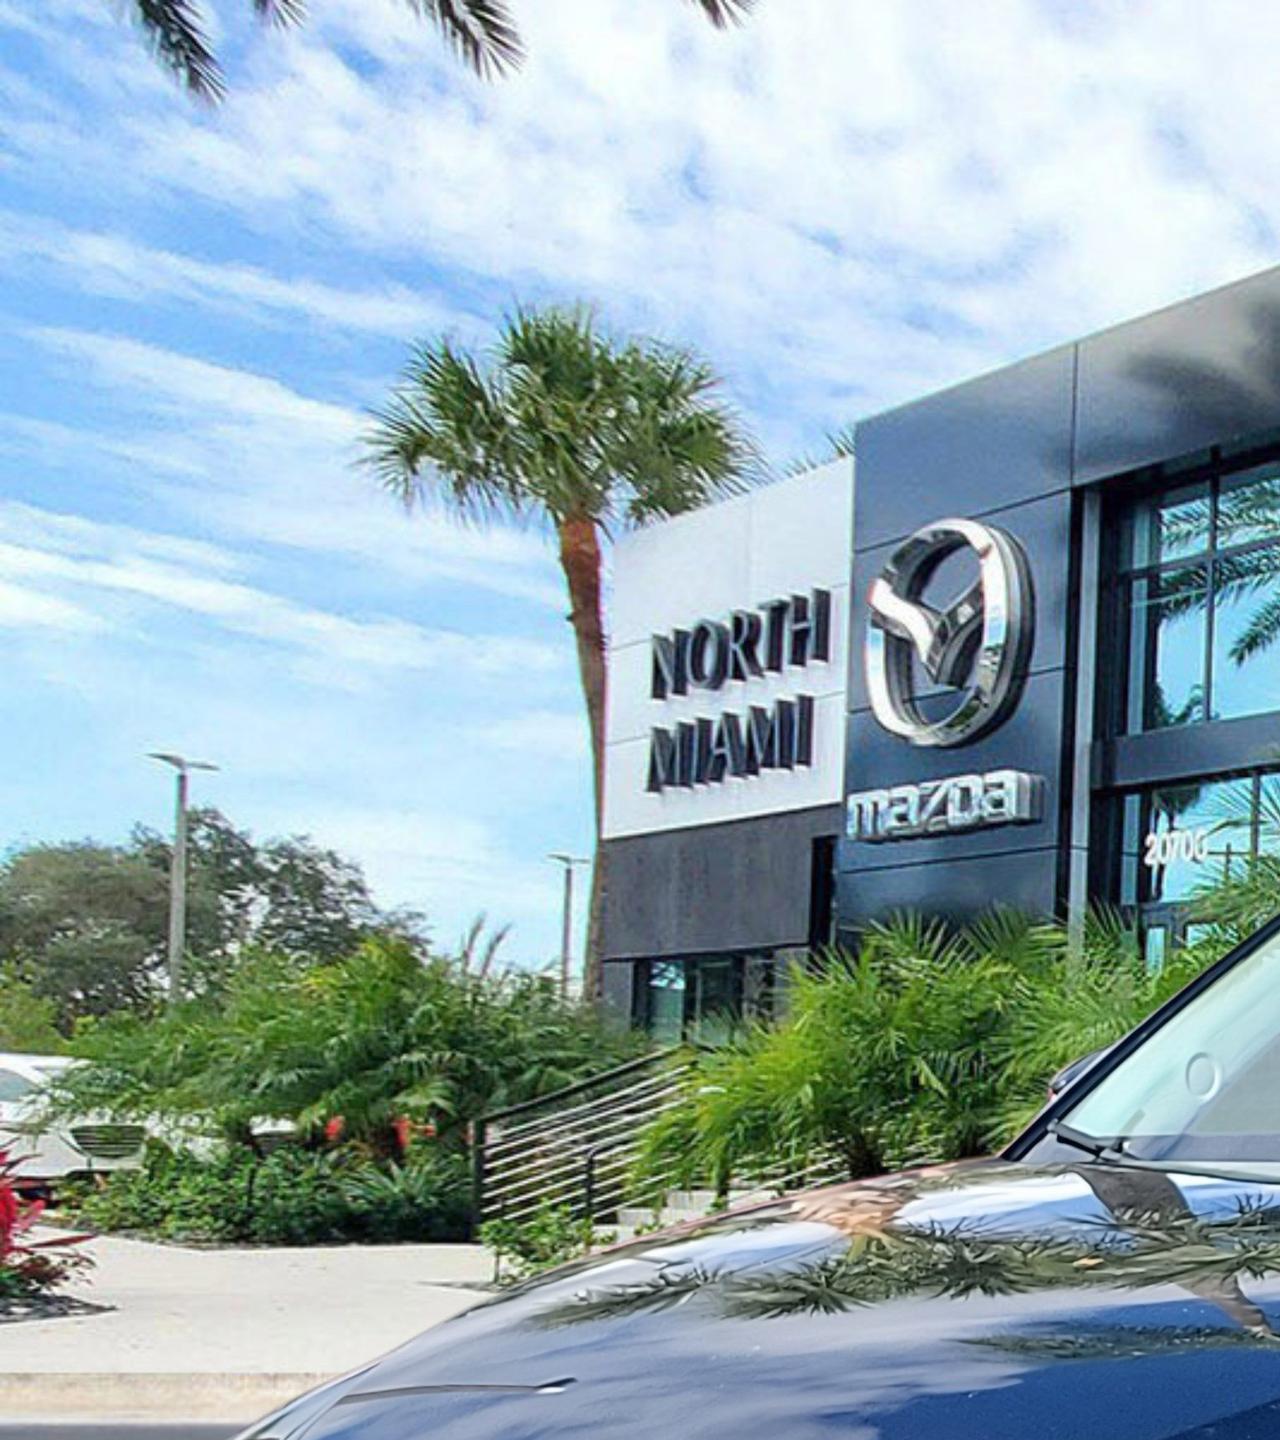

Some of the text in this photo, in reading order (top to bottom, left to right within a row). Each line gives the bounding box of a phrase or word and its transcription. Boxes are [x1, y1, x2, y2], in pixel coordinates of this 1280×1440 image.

[651, 588, 831, 699] NORTH
[647, 695, 814, 792] MIAMI
[1144, 830, 1208, 865] 20700
